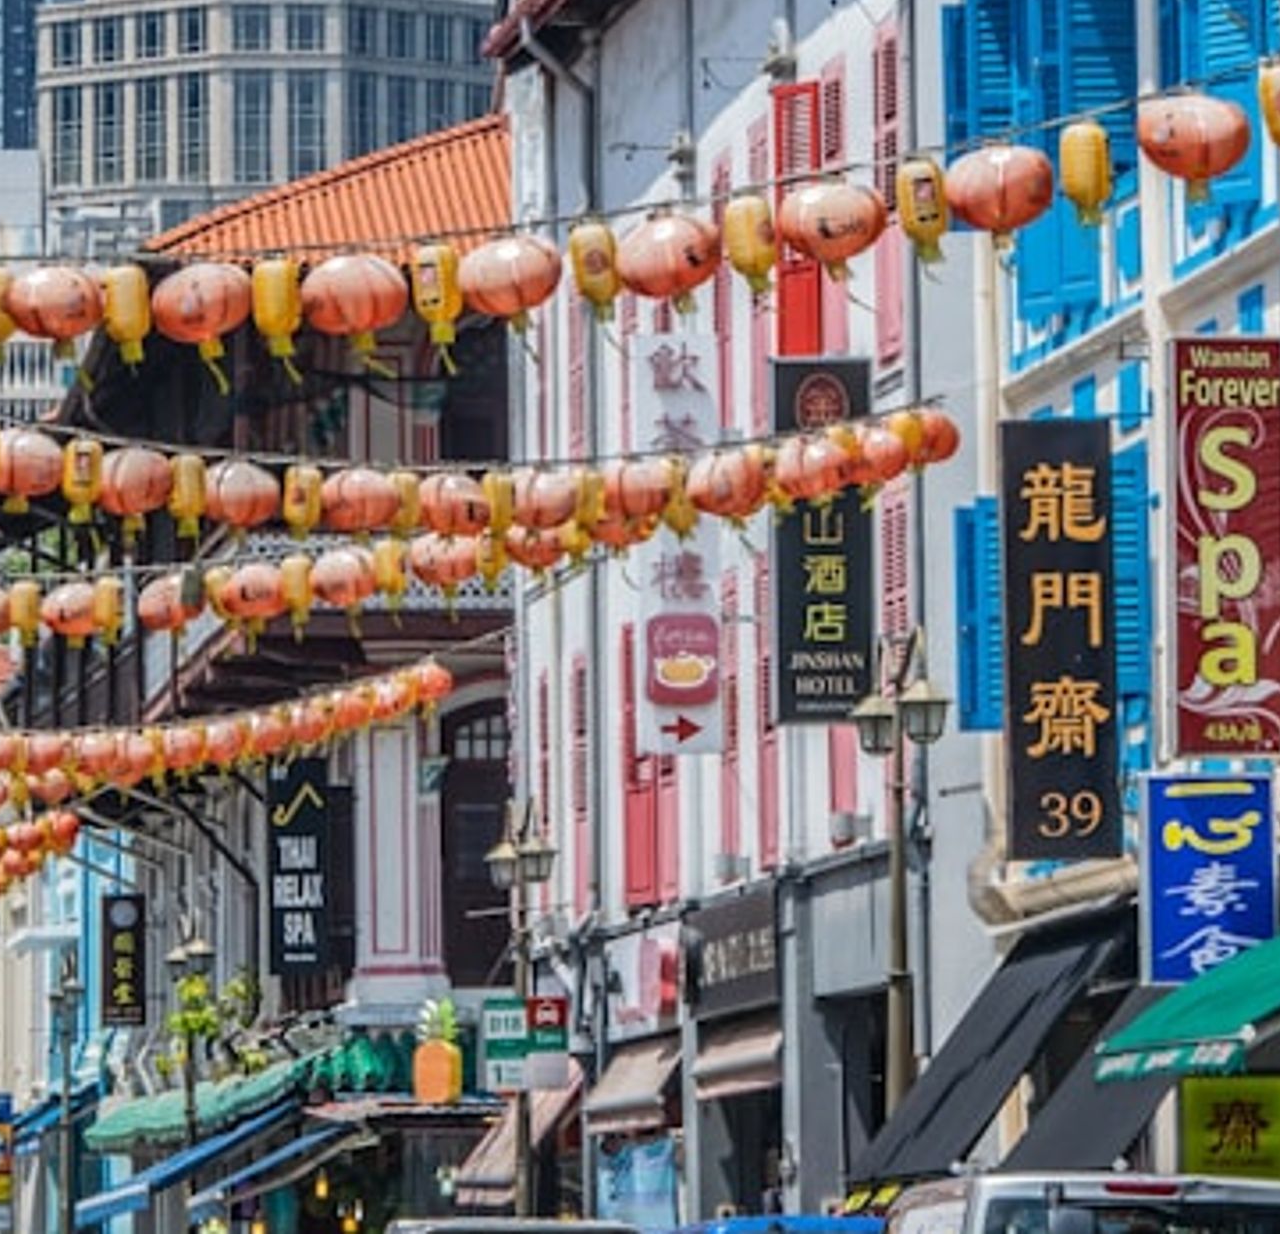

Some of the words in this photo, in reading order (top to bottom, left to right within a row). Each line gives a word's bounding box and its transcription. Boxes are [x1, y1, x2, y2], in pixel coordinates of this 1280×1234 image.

[1181, 369, 1280, 407] Forever
[795, 676, 855, 695] HOTEL
[1037, 791, 1102, 837] 39
[273, 875, 323, 908] RELAX
[283, 913, 315, 945] SPA
